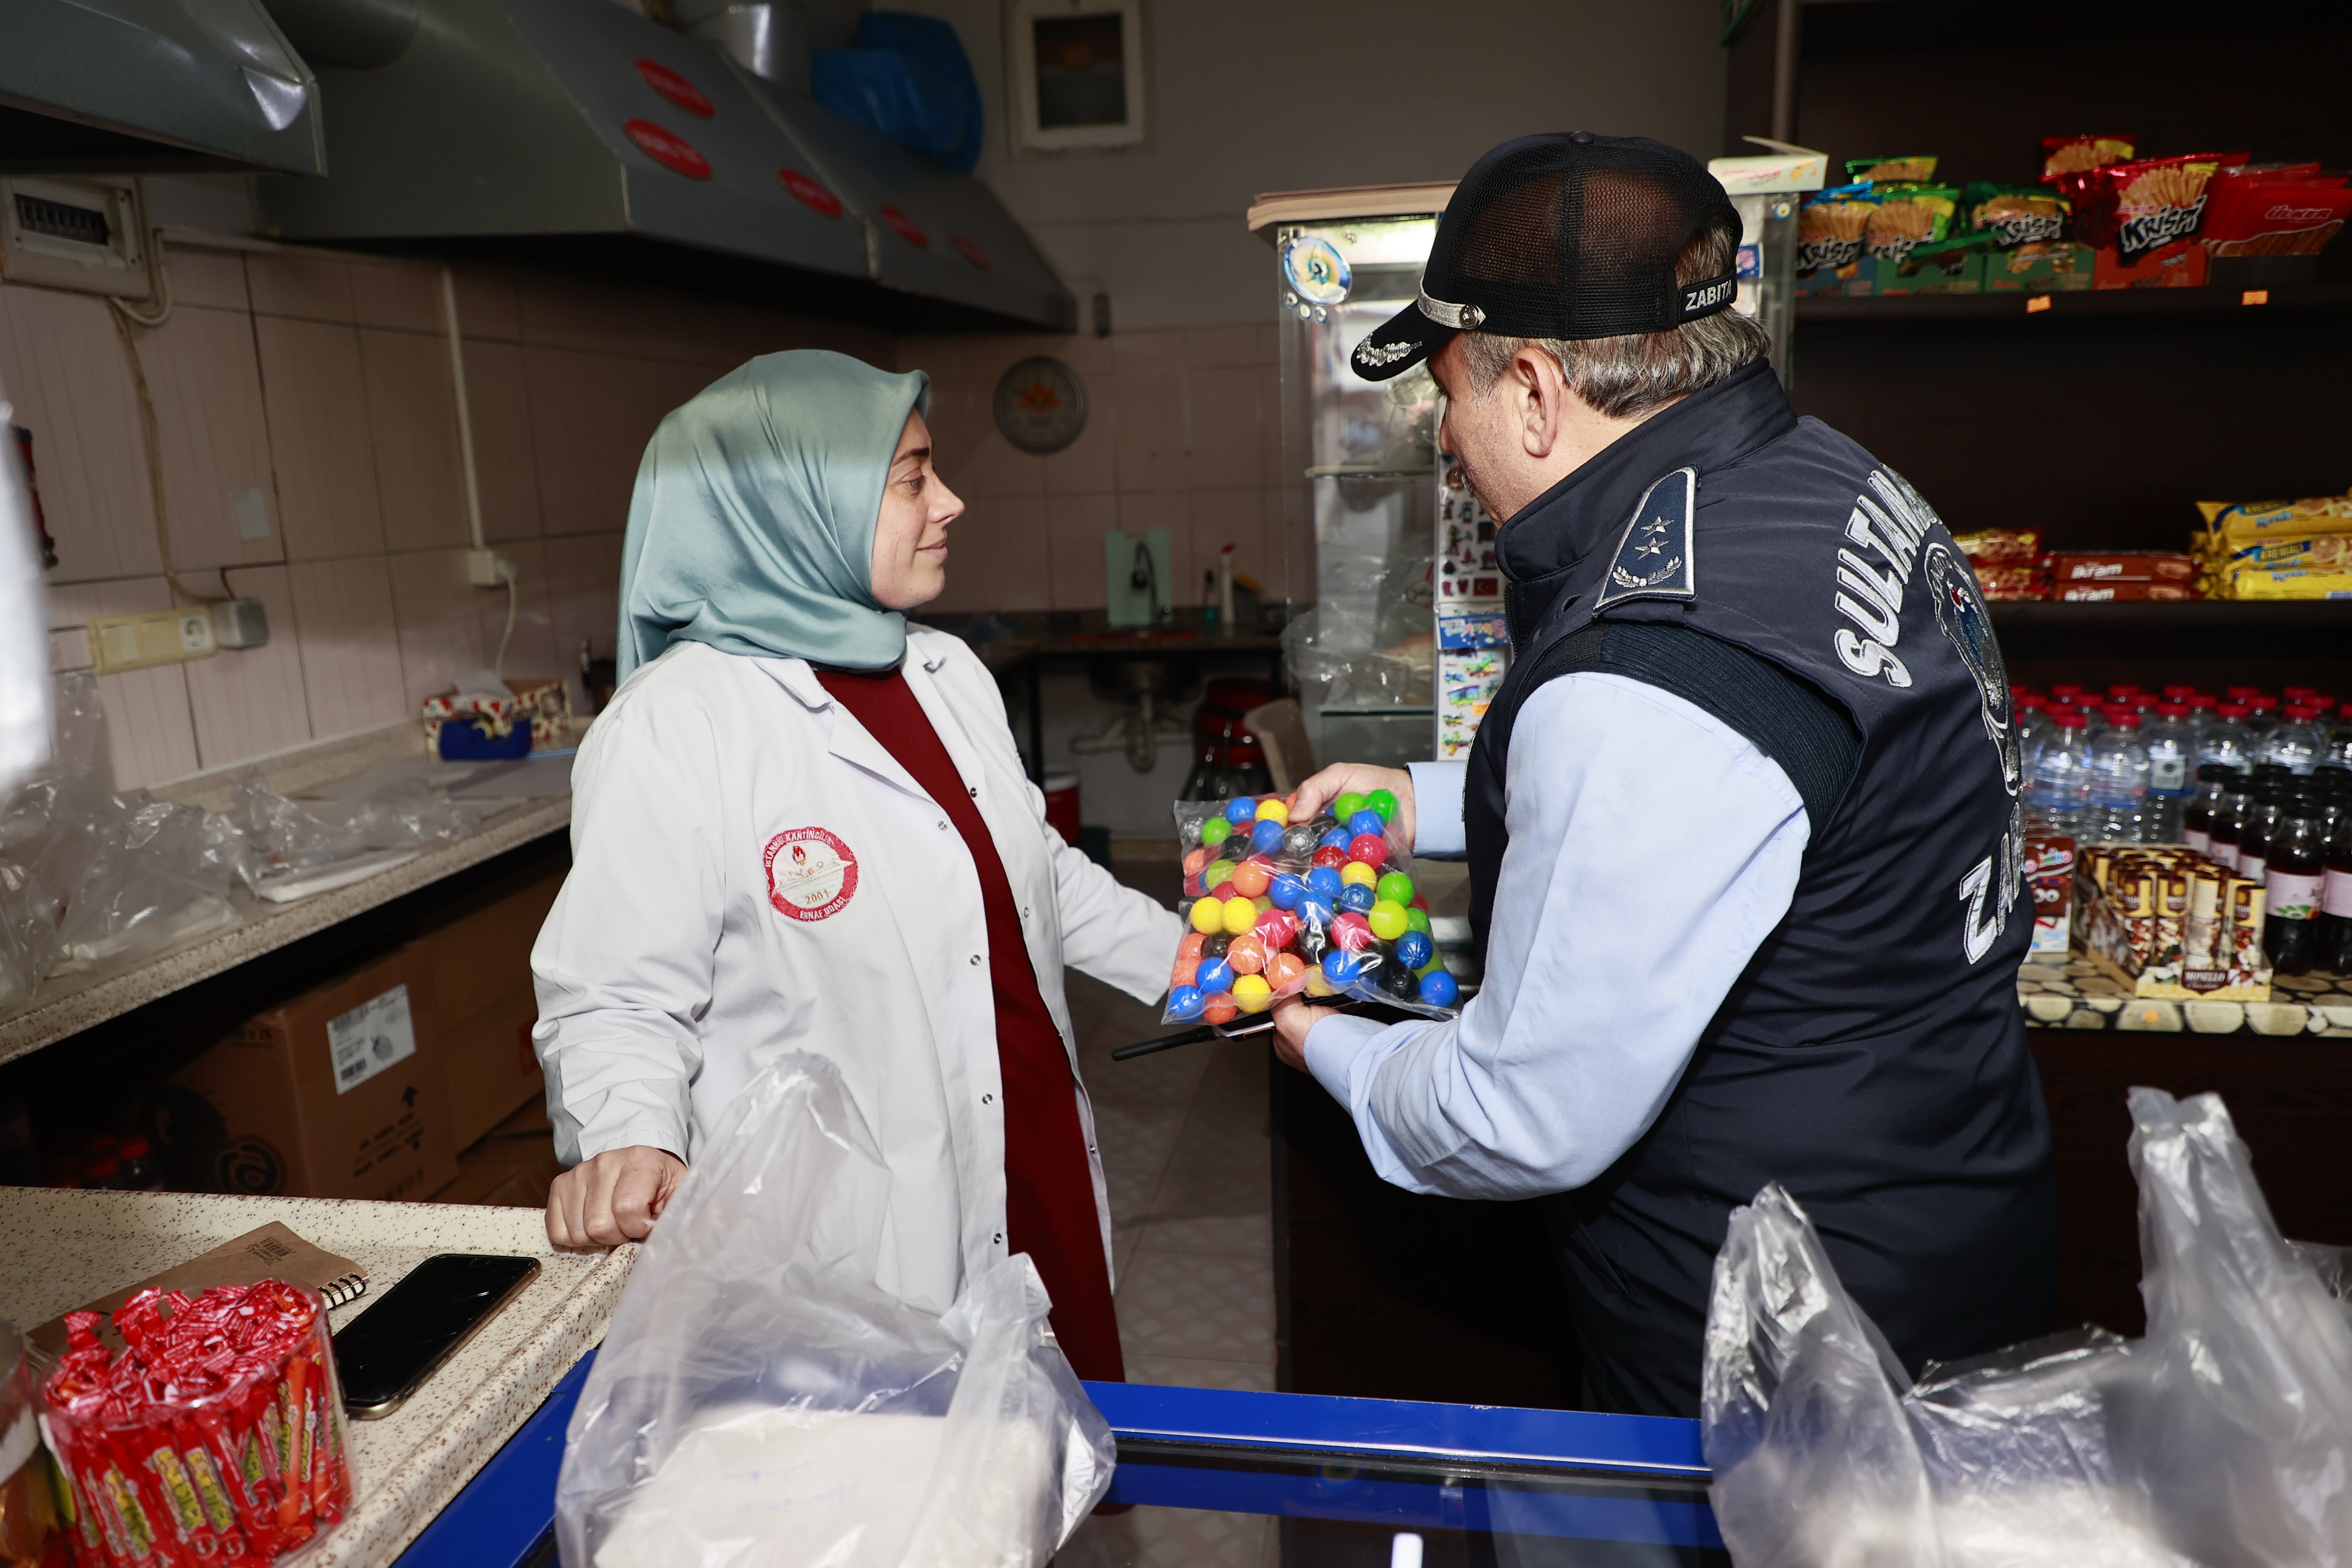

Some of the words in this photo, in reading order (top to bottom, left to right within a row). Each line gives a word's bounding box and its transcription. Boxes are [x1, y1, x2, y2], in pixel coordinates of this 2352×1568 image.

[1685, 279, 1723, 311] ZABITA
[799, 910, 823, 919] ESNAF
[823, 896, 846, 915] ODASI
[805, 889, 830, 905] 2001
